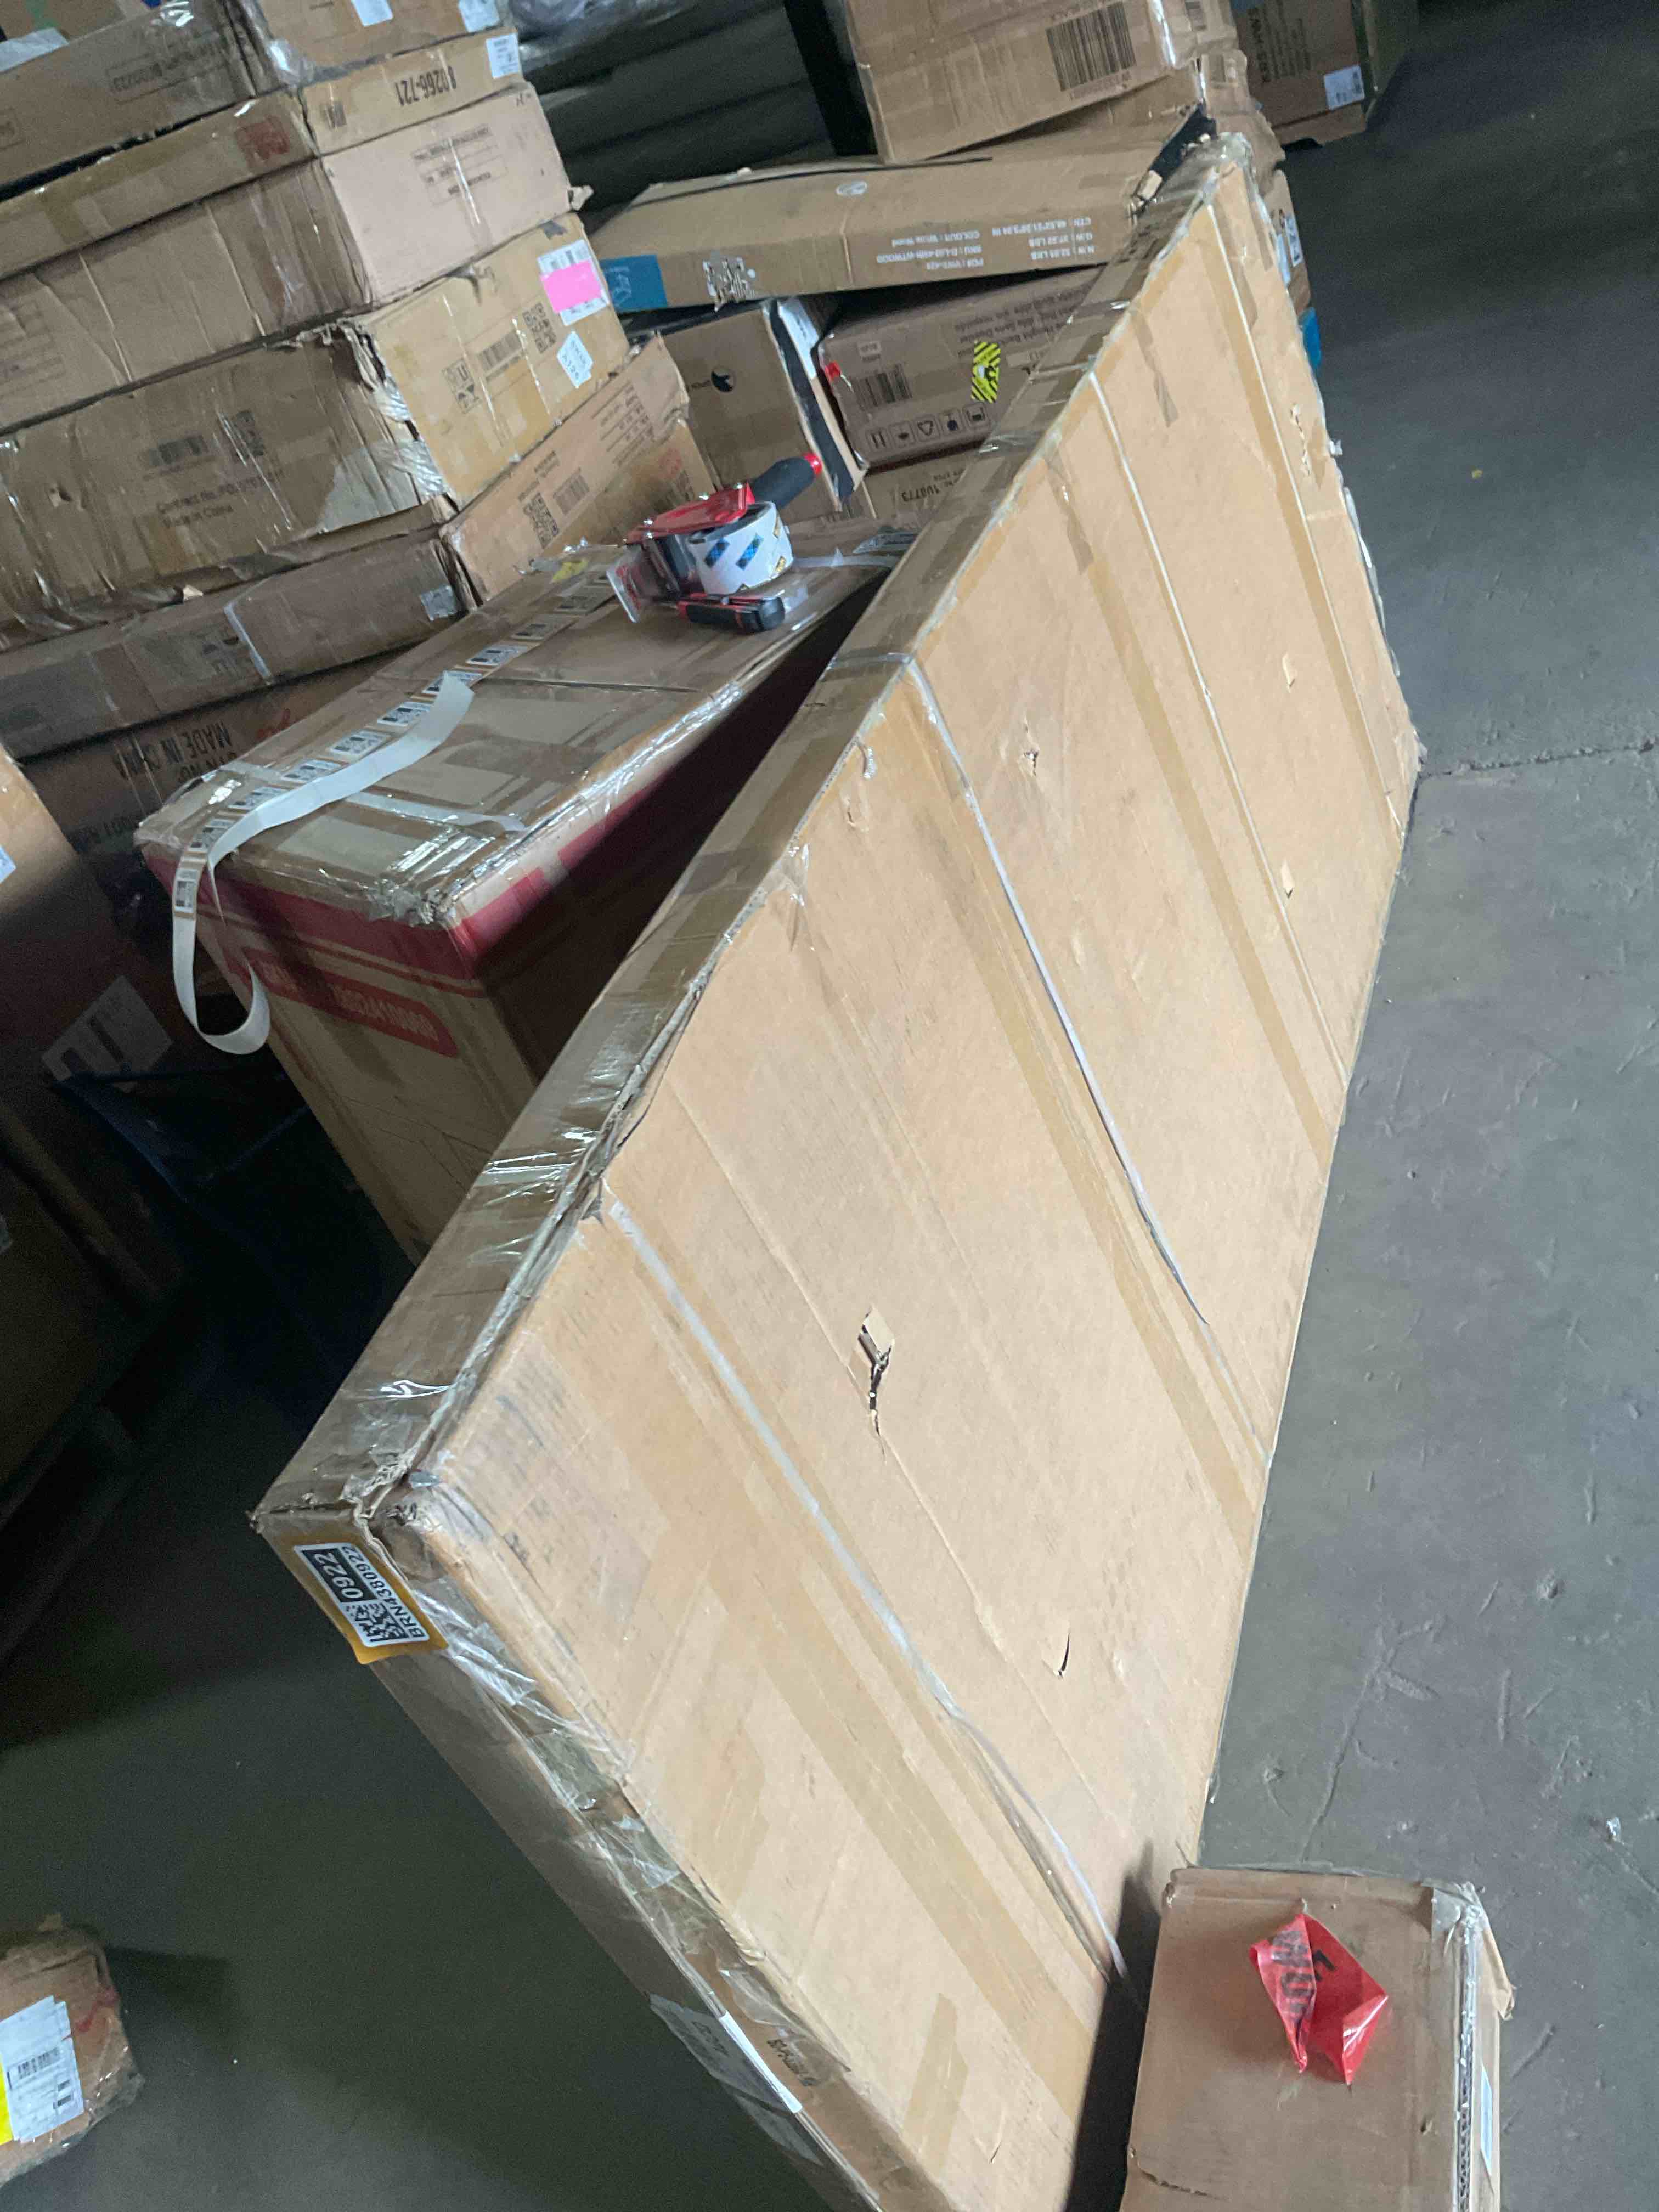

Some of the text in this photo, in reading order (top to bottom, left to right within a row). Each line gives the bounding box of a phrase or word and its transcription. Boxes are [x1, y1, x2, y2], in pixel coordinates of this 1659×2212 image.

[395, 66, 457, 106] 80266-721
[183, 721, 232, 758] MADE
[315, 1551, 364, 1599] 0922
[343, 1545, 425, 1638] BRN4380922
